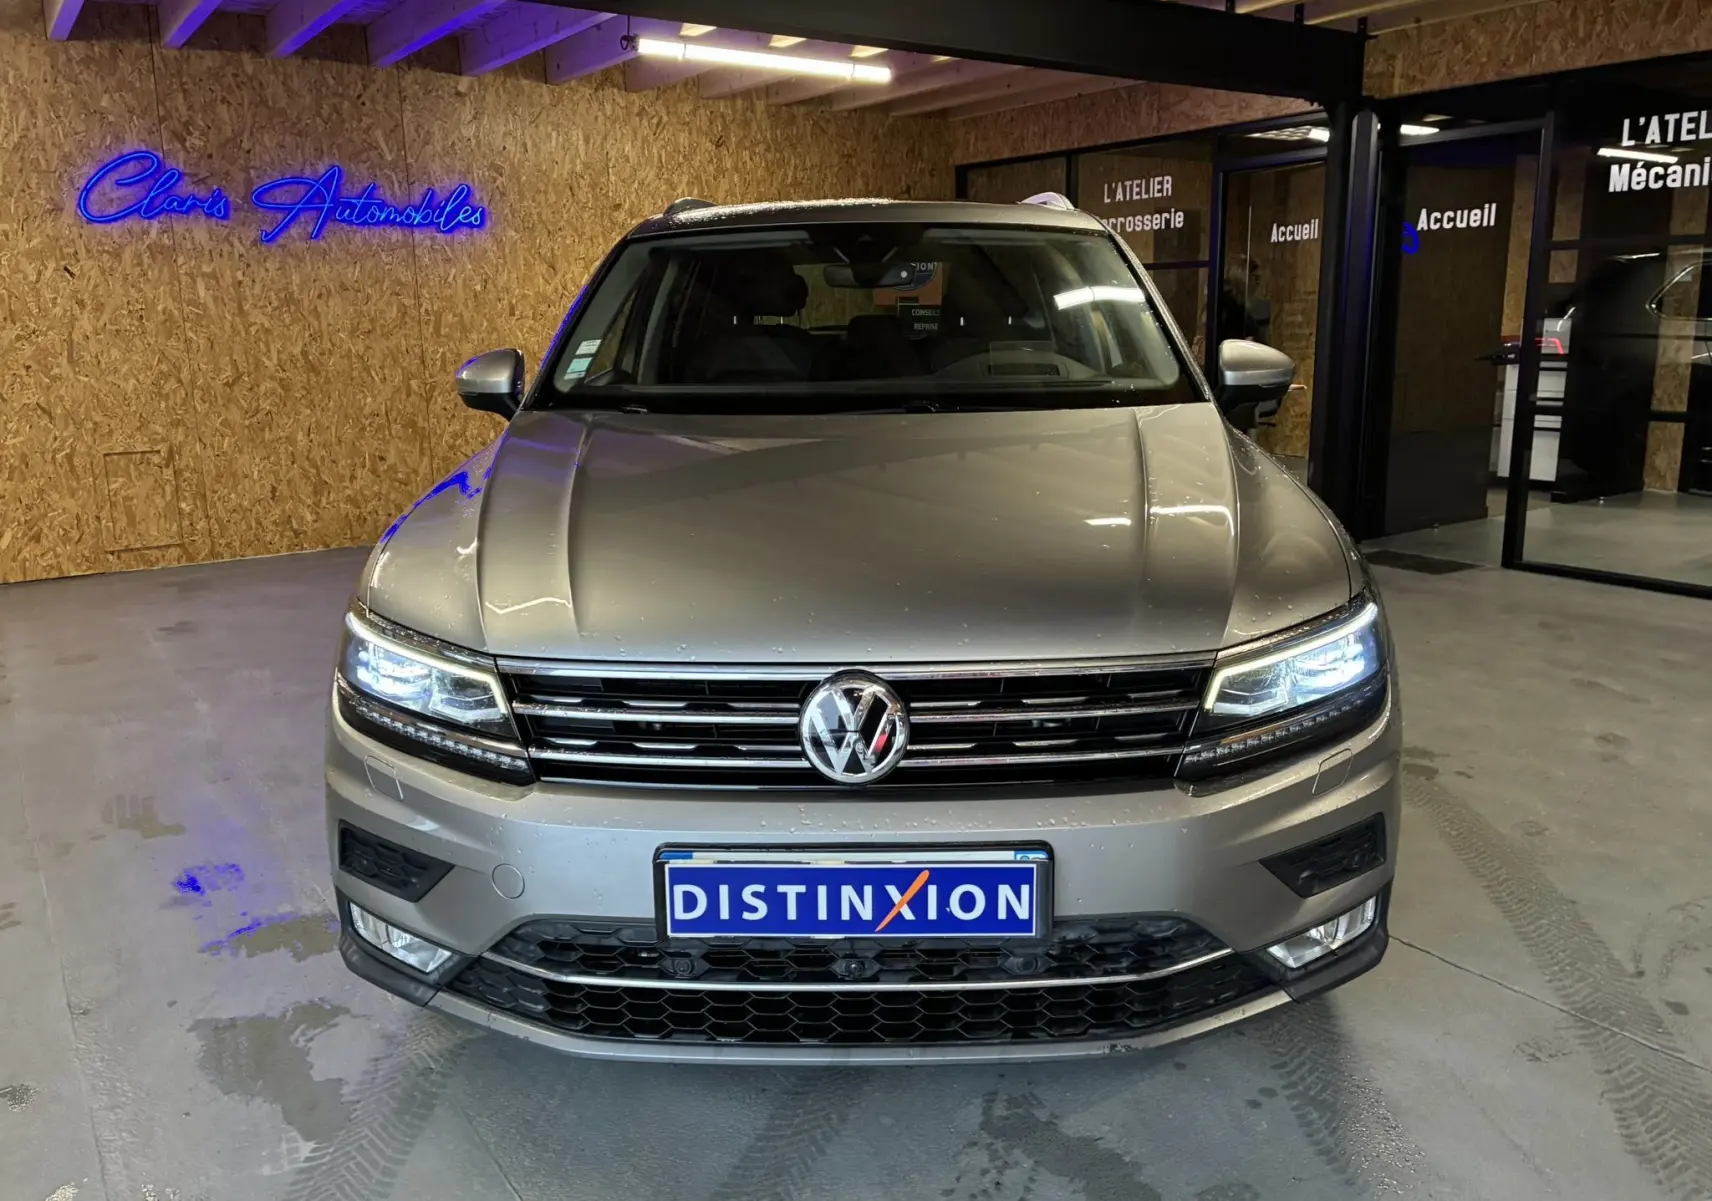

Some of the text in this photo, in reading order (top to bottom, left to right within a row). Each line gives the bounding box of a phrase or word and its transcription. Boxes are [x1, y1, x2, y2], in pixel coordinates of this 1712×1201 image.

[1103, 175, 1172, 204] L'ATELIER
[1608, 156, 1712, 193] Mécani
[79, 150, 484, 242] Claris Automobiles
[1270, 218, 1319, 243] Accueil
[1416, 202, 1497, 231] Accueil
[672, 870, 1030, 931] DISTINXION
